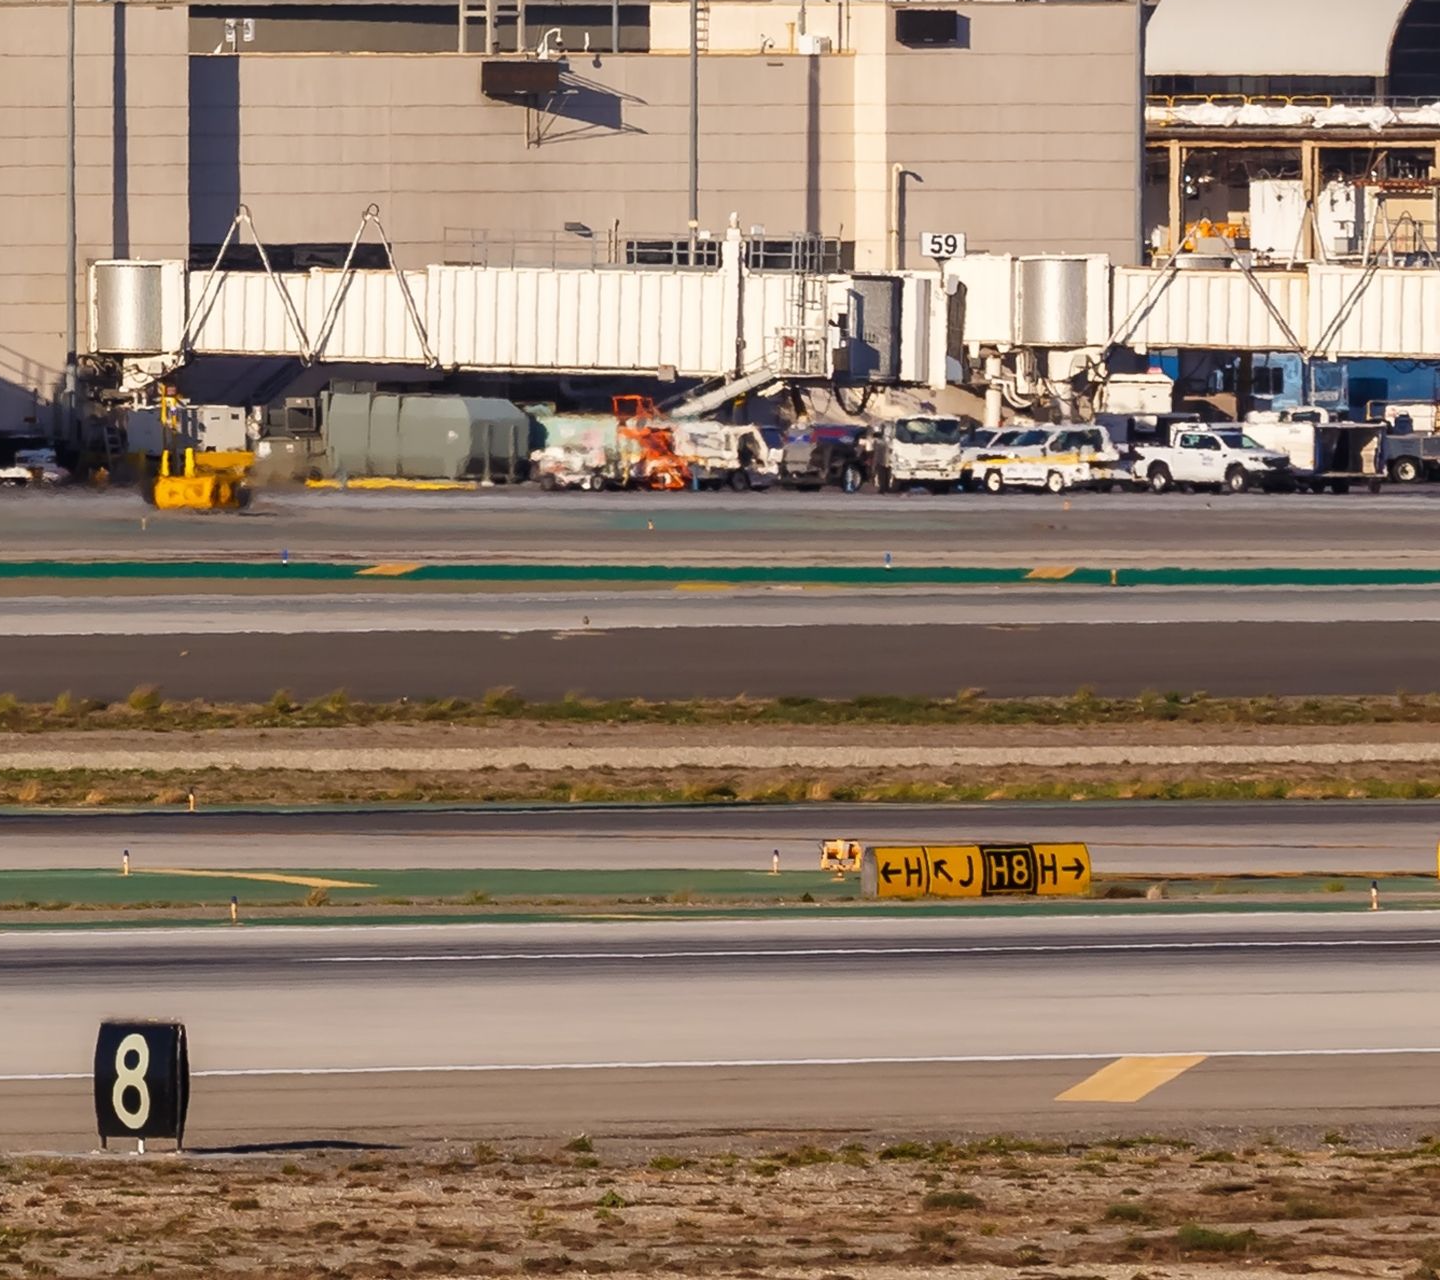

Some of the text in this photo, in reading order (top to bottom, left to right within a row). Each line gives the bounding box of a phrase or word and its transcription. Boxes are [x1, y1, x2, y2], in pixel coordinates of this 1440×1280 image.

[930, 234, 958, 255] 59
[905, 853, 1058, 888] H J H8 H
[112, 1032, 151, 1130] 8
